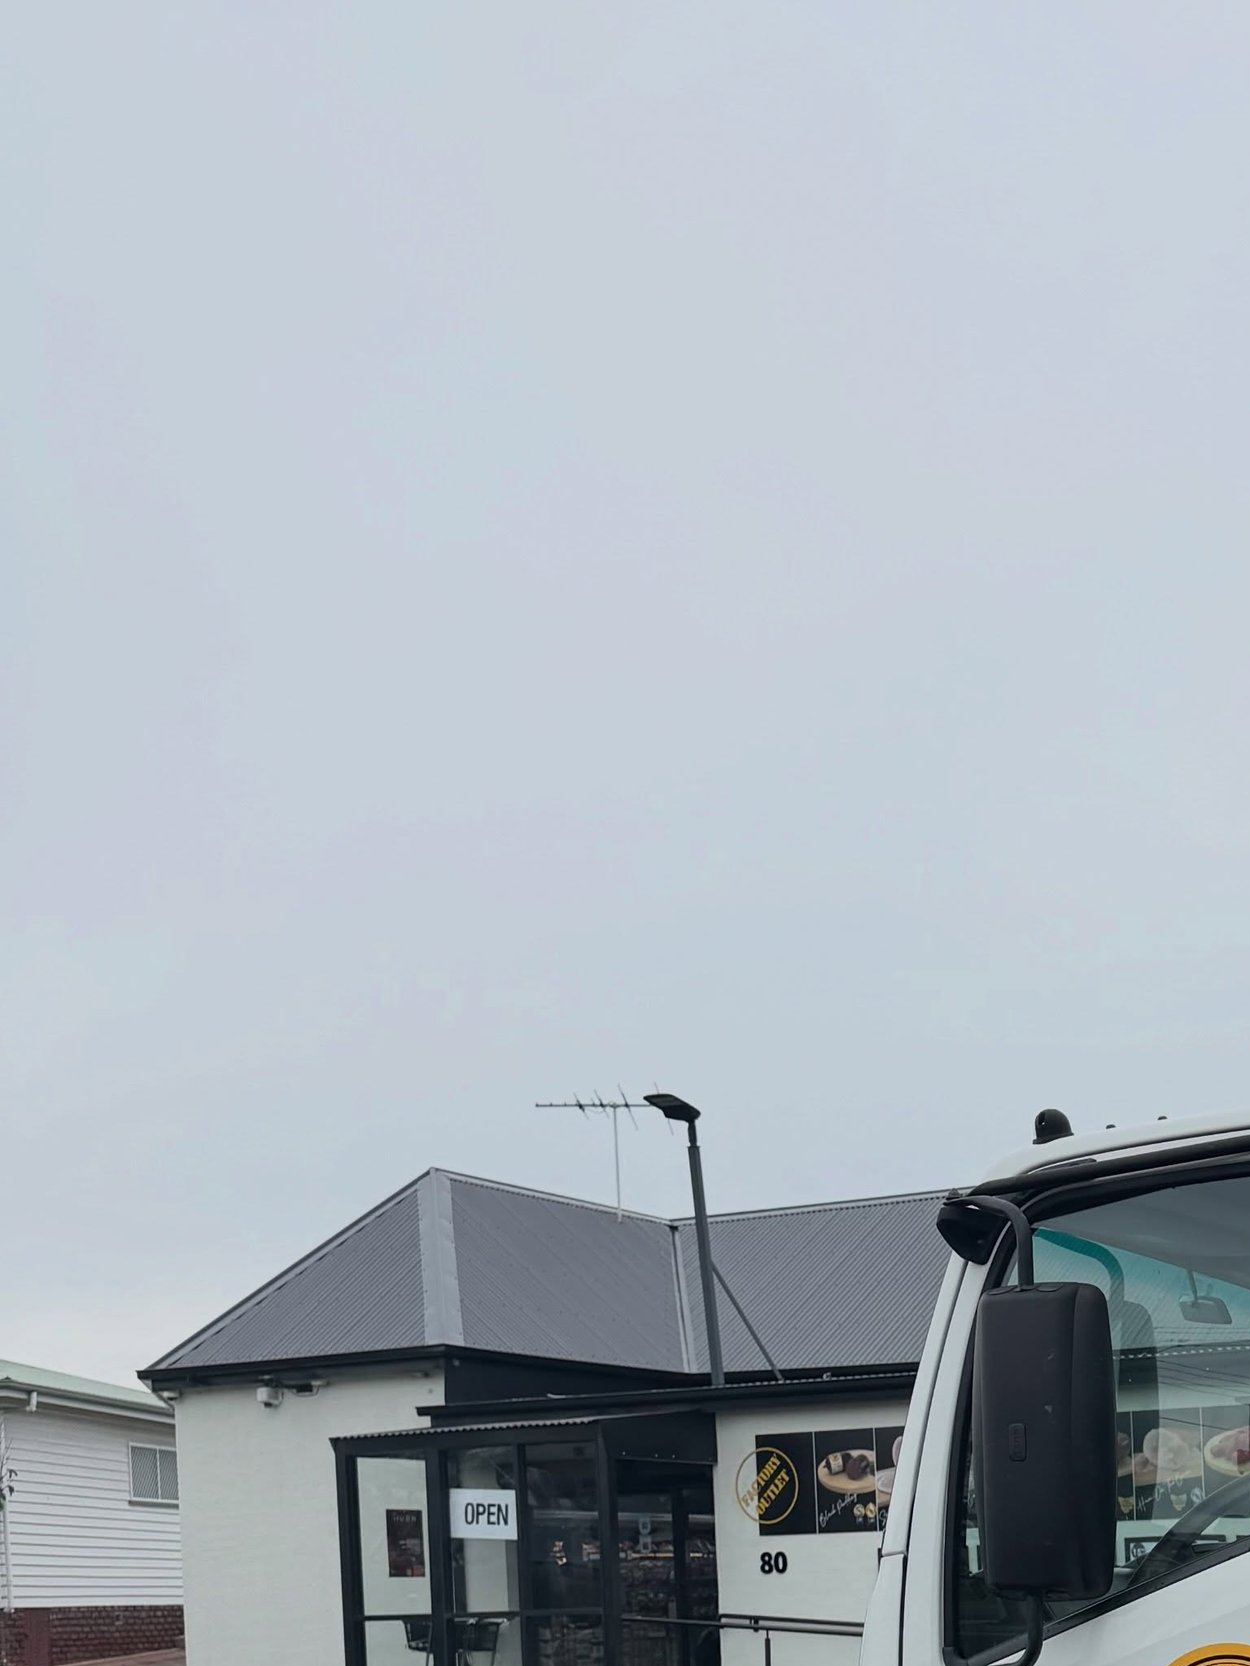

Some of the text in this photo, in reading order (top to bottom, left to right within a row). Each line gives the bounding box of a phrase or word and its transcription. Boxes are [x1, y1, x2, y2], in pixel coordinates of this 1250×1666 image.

[741, 1453, 782, 1508] FACTORY
[755, 1469, 790, 1515] OUTLET
[464, 1502, 509, 1526] OPEN
[759, 1551, 789, 1575] 80
